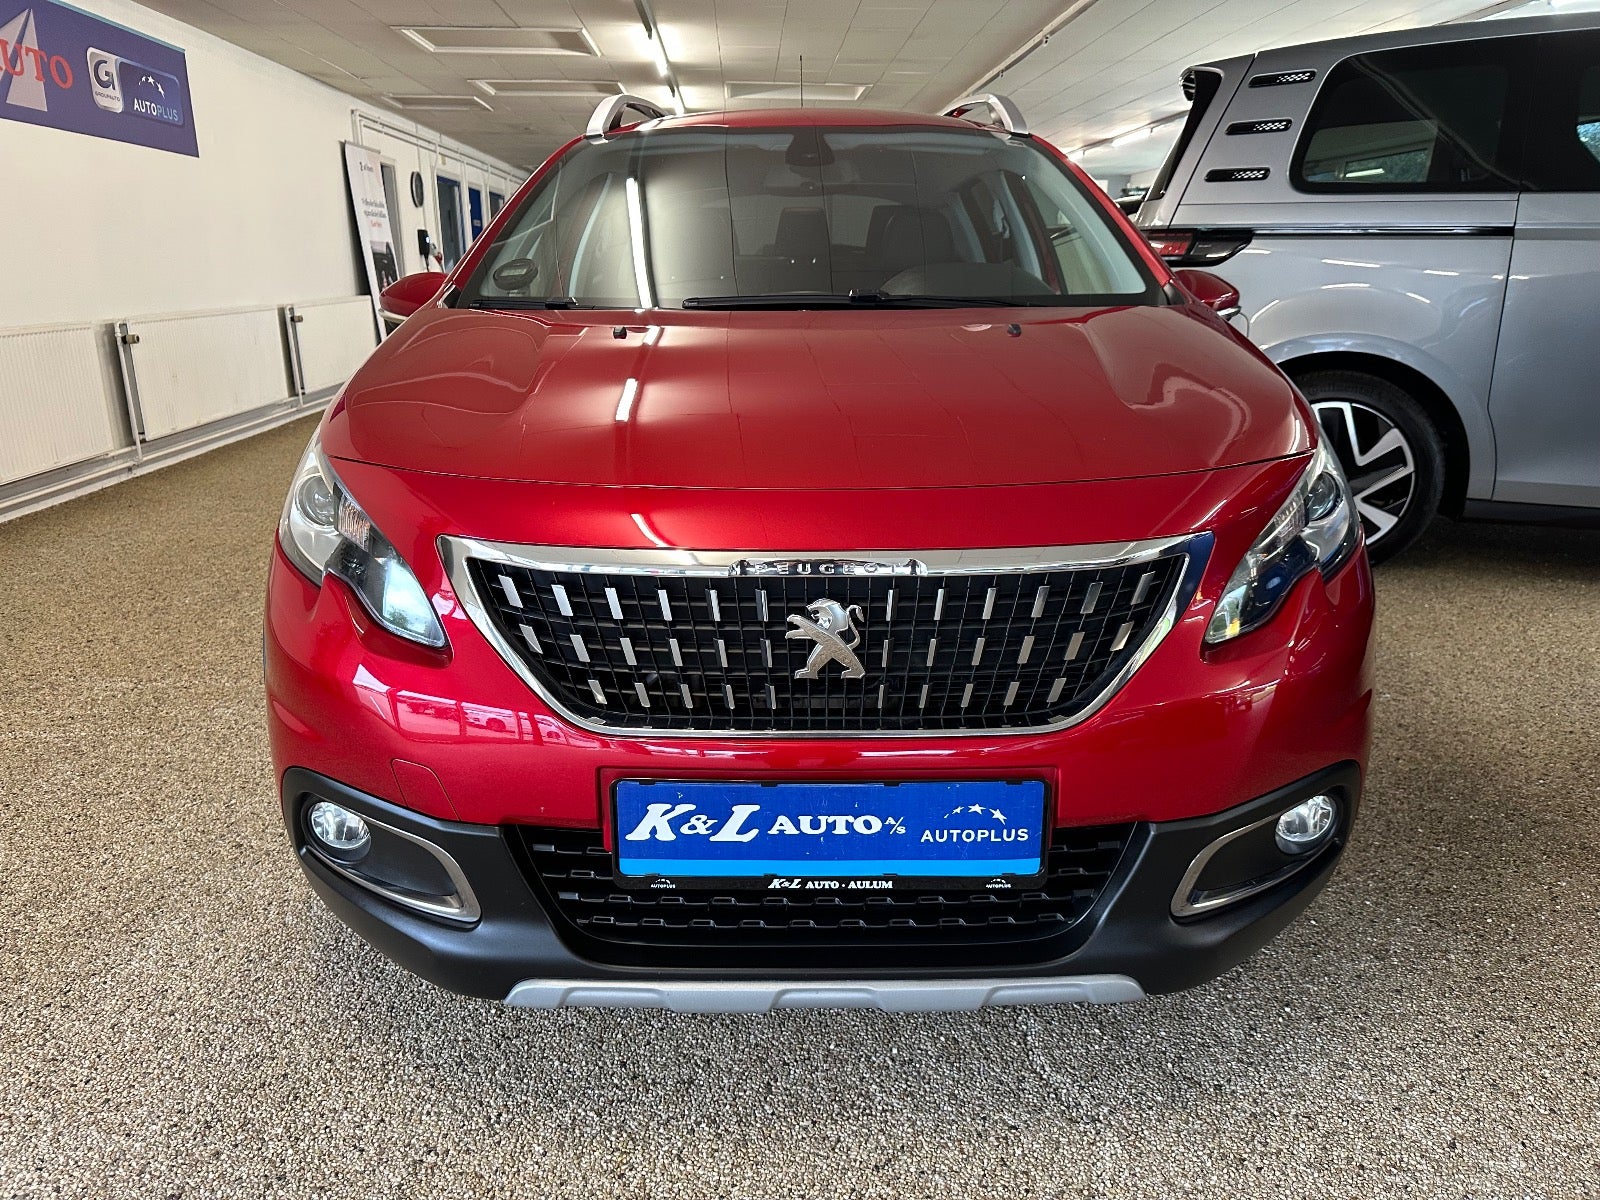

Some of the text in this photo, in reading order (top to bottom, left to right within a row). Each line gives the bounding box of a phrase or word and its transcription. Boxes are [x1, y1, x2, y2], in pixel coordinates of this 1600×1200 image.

[0, 39, 73, 89] UTO
[133, 97, 179, 122] AUTOPLUS
[626, 803, 760, 842] K&L
[768, 815, 882, 834] AUTO
[921, 829, 1029, 843] AUTOPLUS
[768, 878, 893, 889] K&L AUTO AULUM
